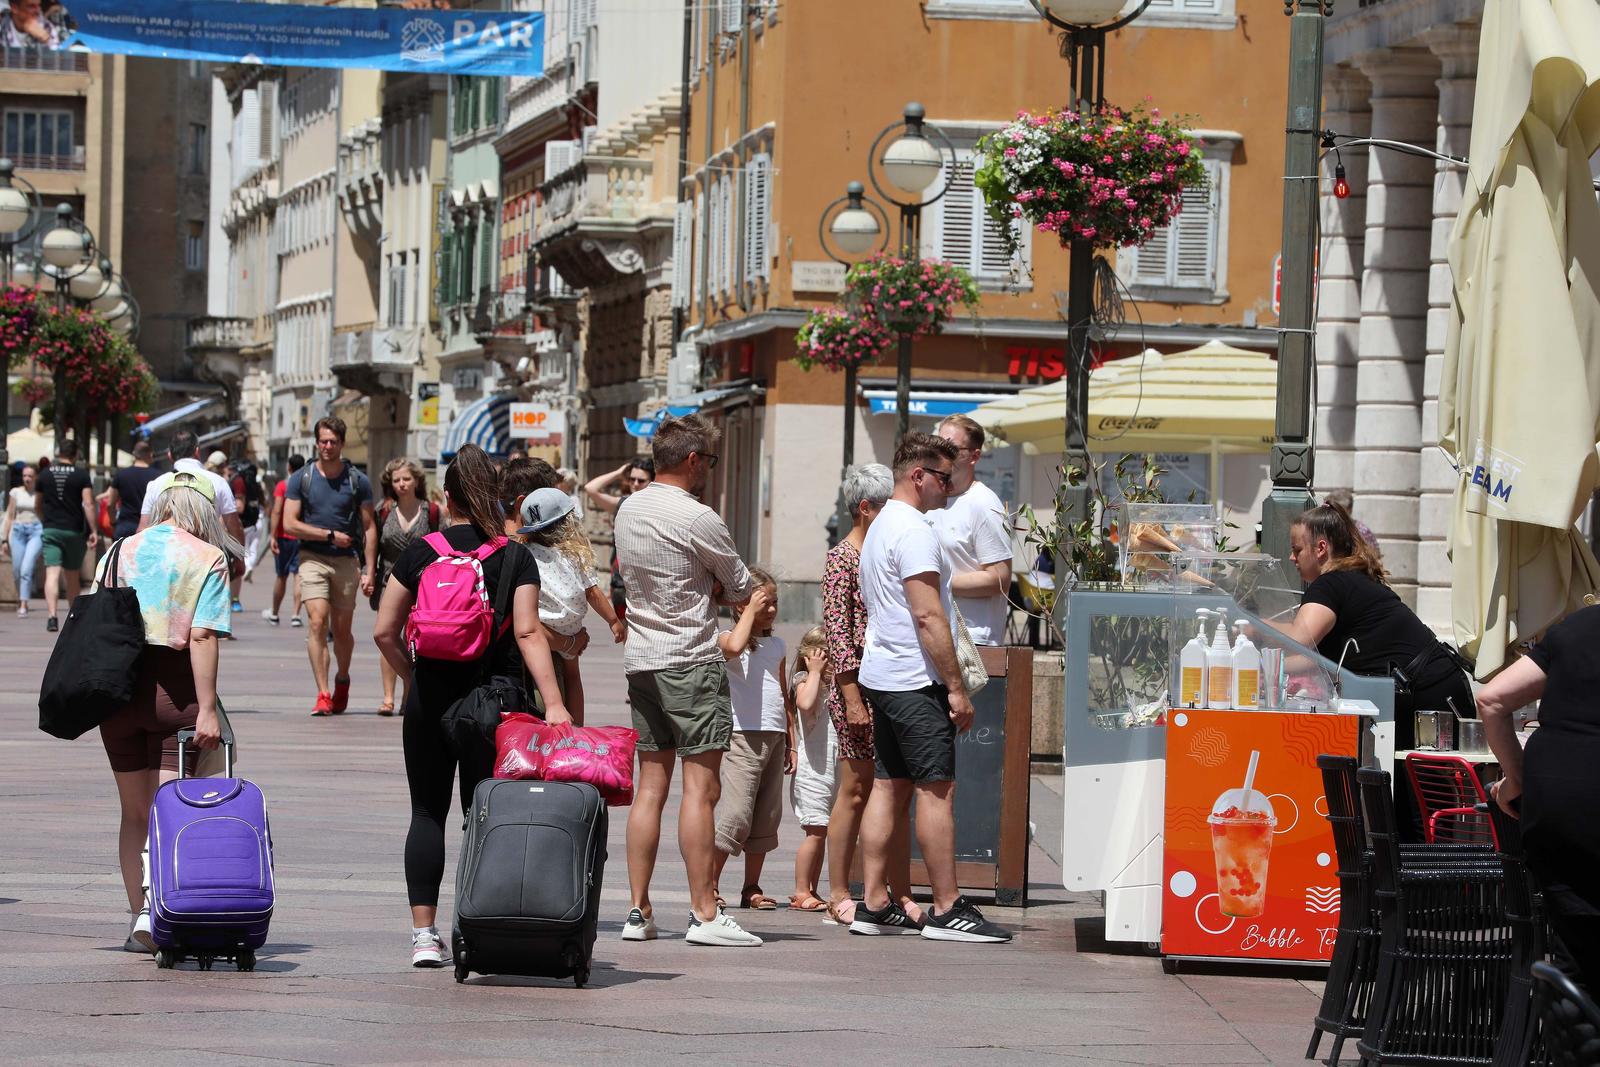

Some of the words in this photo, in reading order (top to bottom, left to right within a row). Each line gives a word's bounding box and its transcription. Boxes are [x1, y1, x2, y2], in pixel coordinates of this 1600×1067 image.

[136, 26, 142, 35] 9
[189, 29, 202, 38] 40
[290, 35, 341, 46] studenata
[149, 17, 171, 26] PAR
[173, 19, 190, 28] dio
[191, 20, 202, 29] je
[204, 20, 256, 32] Europskog
[313, 26, 352, 36] dualnih
[355, 29, 390, 39] studija
[453, 19, 533, 48] PAR
[513, 412, 546, 425] HOP
[1240, 924, 1305, 951] Bubble
